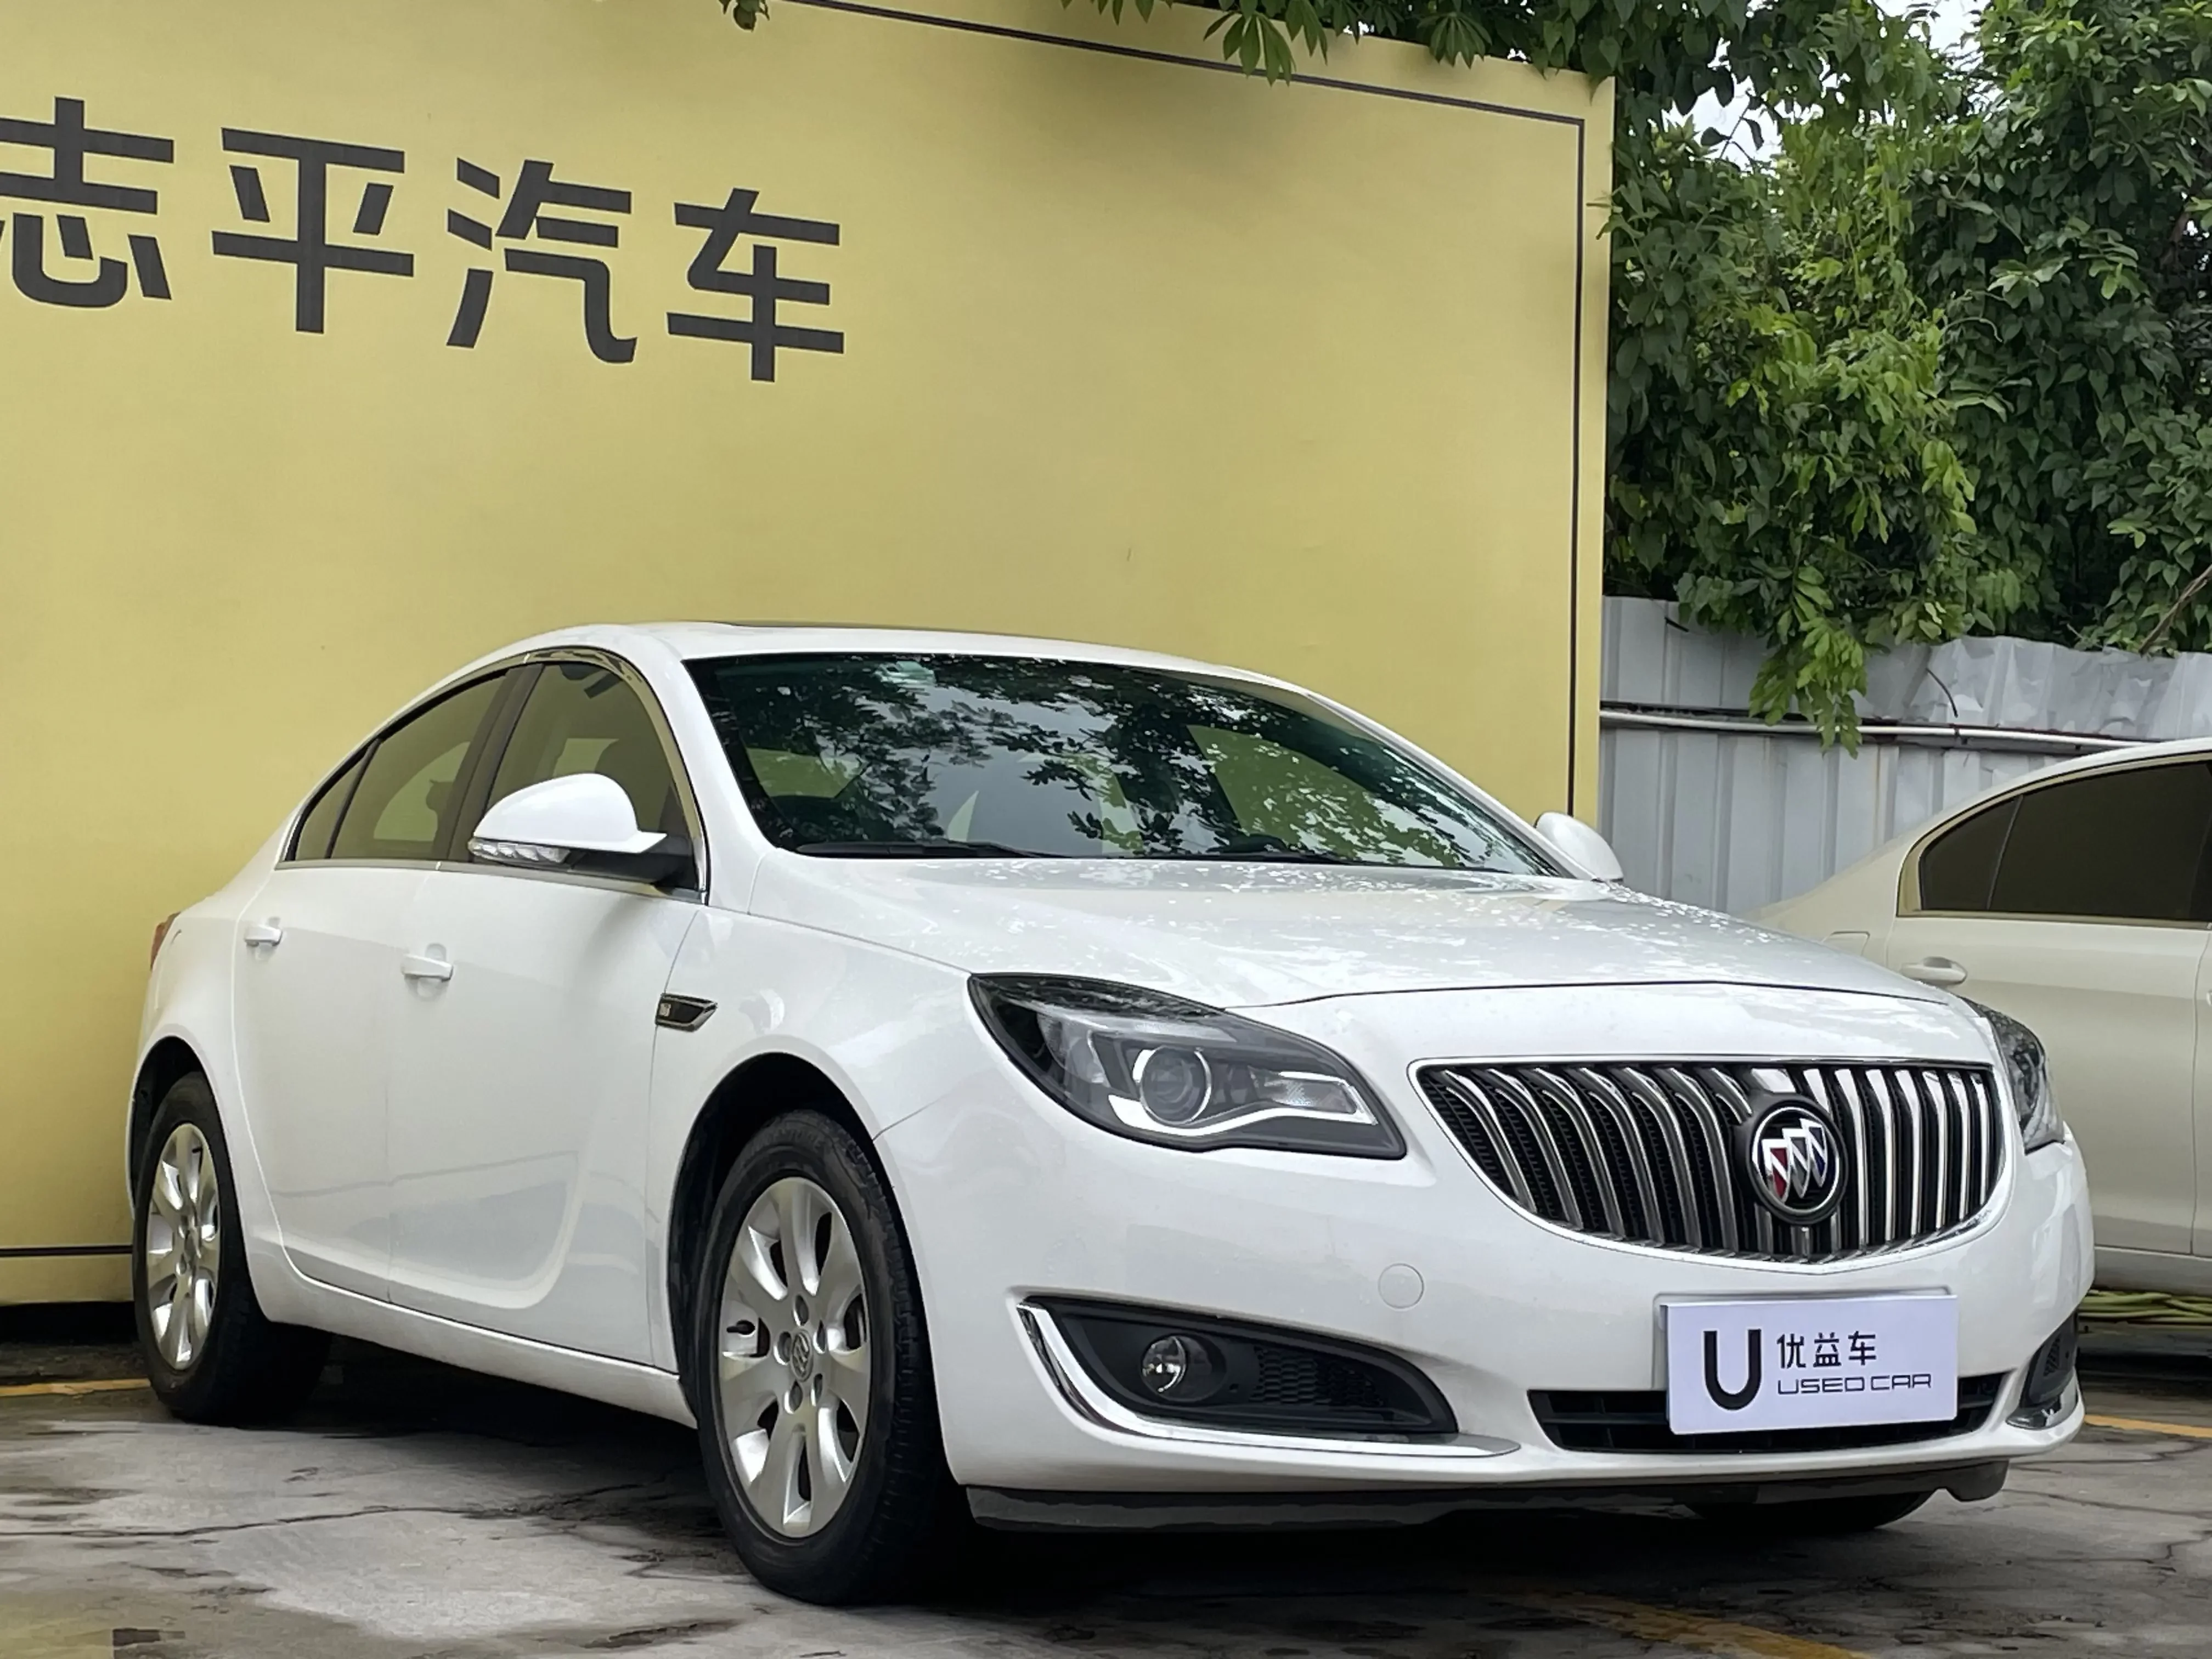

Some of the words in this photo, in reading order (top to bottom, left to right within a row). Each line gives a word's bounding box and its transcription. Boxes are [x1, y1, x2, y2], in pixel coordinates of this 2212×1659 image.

[0, 97, 844, 382] 志平汽车
[1703, 1328, 1762, 1410] U
[1776, 1330, 1877, 1369] 优益车
[1778, 1376, 1865, 1395] USED
[1871, 1373, 1932, 1391] CAR
